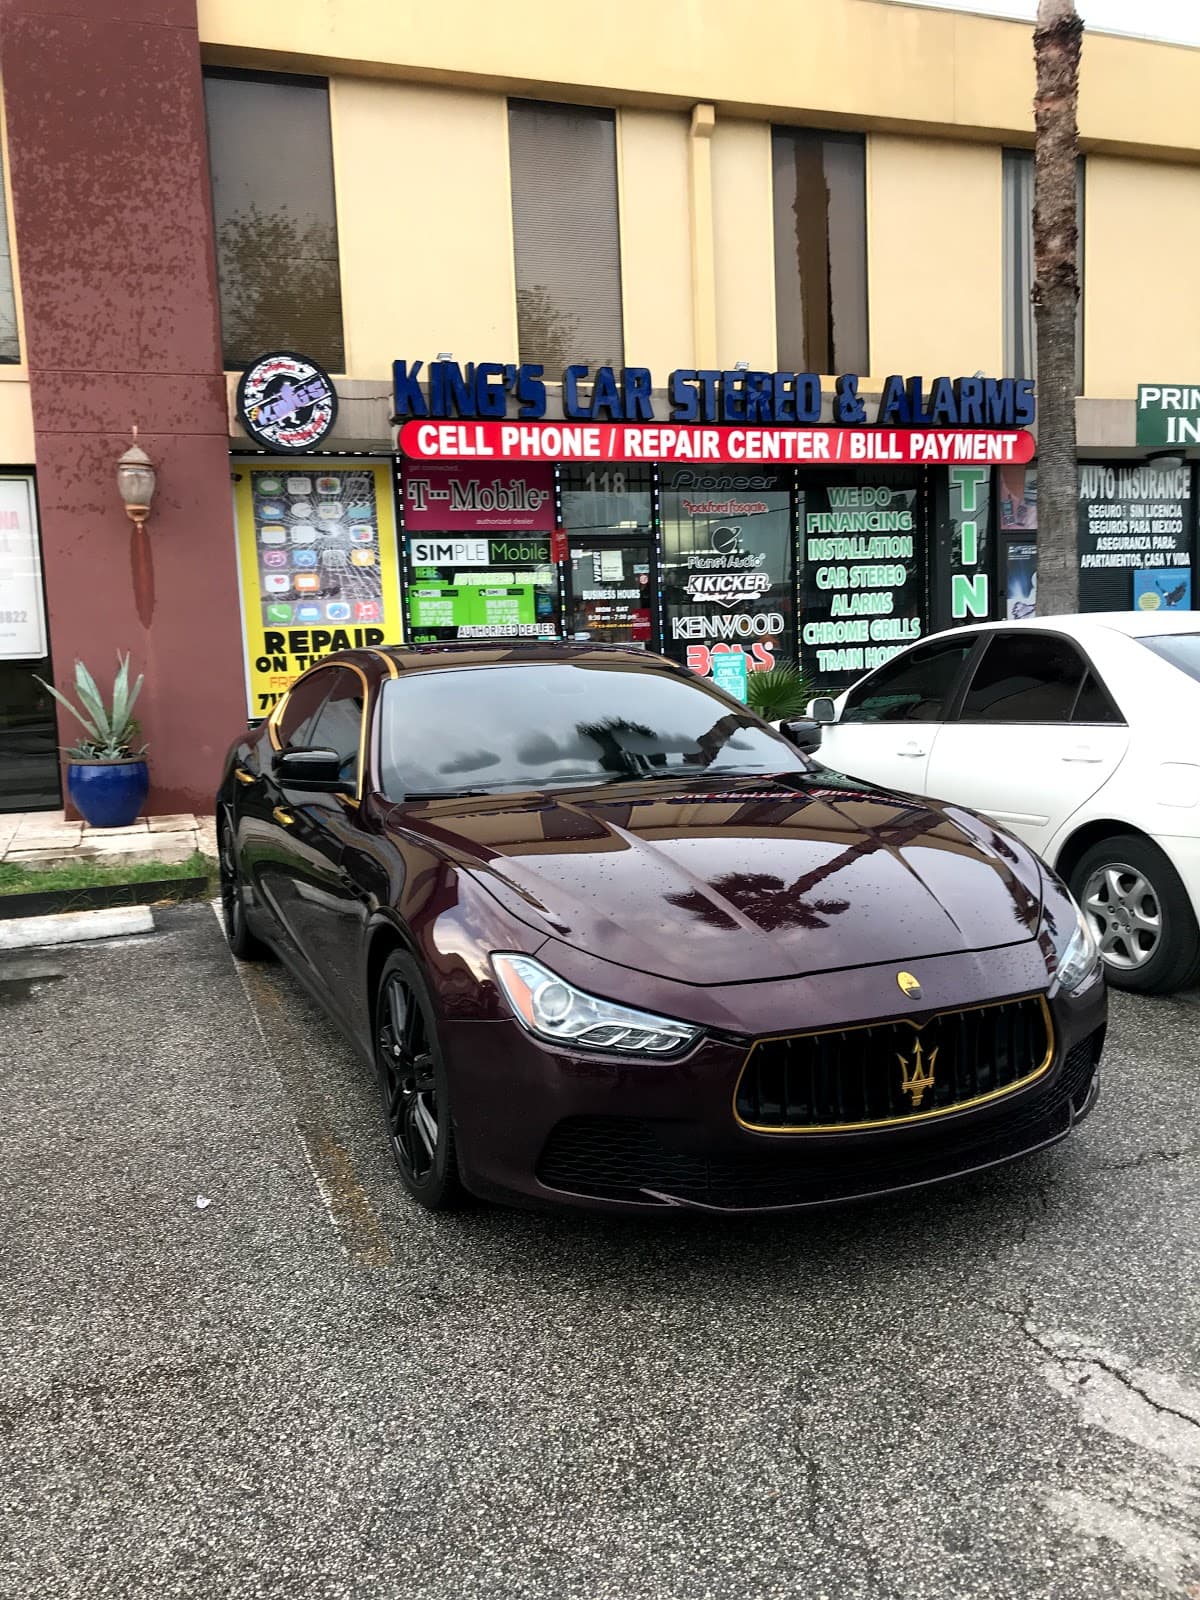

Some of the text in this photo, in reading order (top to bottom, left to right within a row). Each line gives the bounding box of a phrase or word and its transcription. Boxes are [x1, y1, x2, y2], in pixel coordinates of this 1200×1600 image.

[392, 360, 1035, 425] KING'S CAR STEREO & ALARMS
[417, 425, 1018, 460] CELL PHONE / REPAIR CENTER / BILL PAYMENT
[586, 472, 625, 497] 118
[671, 469, 778, 490] Pioneer
[1080, 466, 1191, 499] AUTO INSURANCE
[826, 486, 892, 507] WE DO
[807, 511, 913, 533] FINANCING
[1130, 505, 1144, 518] SIN
[1145, 505, 1182, 518] LICENCIA
[1089, 520, 1183, 534] SEGUROS PARA MEXICO
[416, 539, 486, 561] SIMPLE
[491, 542, 548, 561] Mobile
[808, 536, 913, 561] INSTALLATION
[1096, 536, 1151, 551] ASEGURANZA
[1144, 553, 1165, 567] CASA
[1165, 553, 1172, 566] Y
[1172, 552, 1191, 566] VIDA
[703, 575, 767, 592] KICKER
[816, 564, 907, 589] CAR STEREO
[582, 589, 640, 600] BUSINESS HOURS
[830, 592, 894, 616] ALARMS
[457, 623, 556, 638] AUTHORIZED DEALER
[672, 612, 785, 639] KENWOOD
[803, 617, 921, 645] CHROME GRILLS
[264, 628, 385, 654] REPAIR
[256, 656, 288, 673] ON
[816, 648, 864, 672] TRAIN
